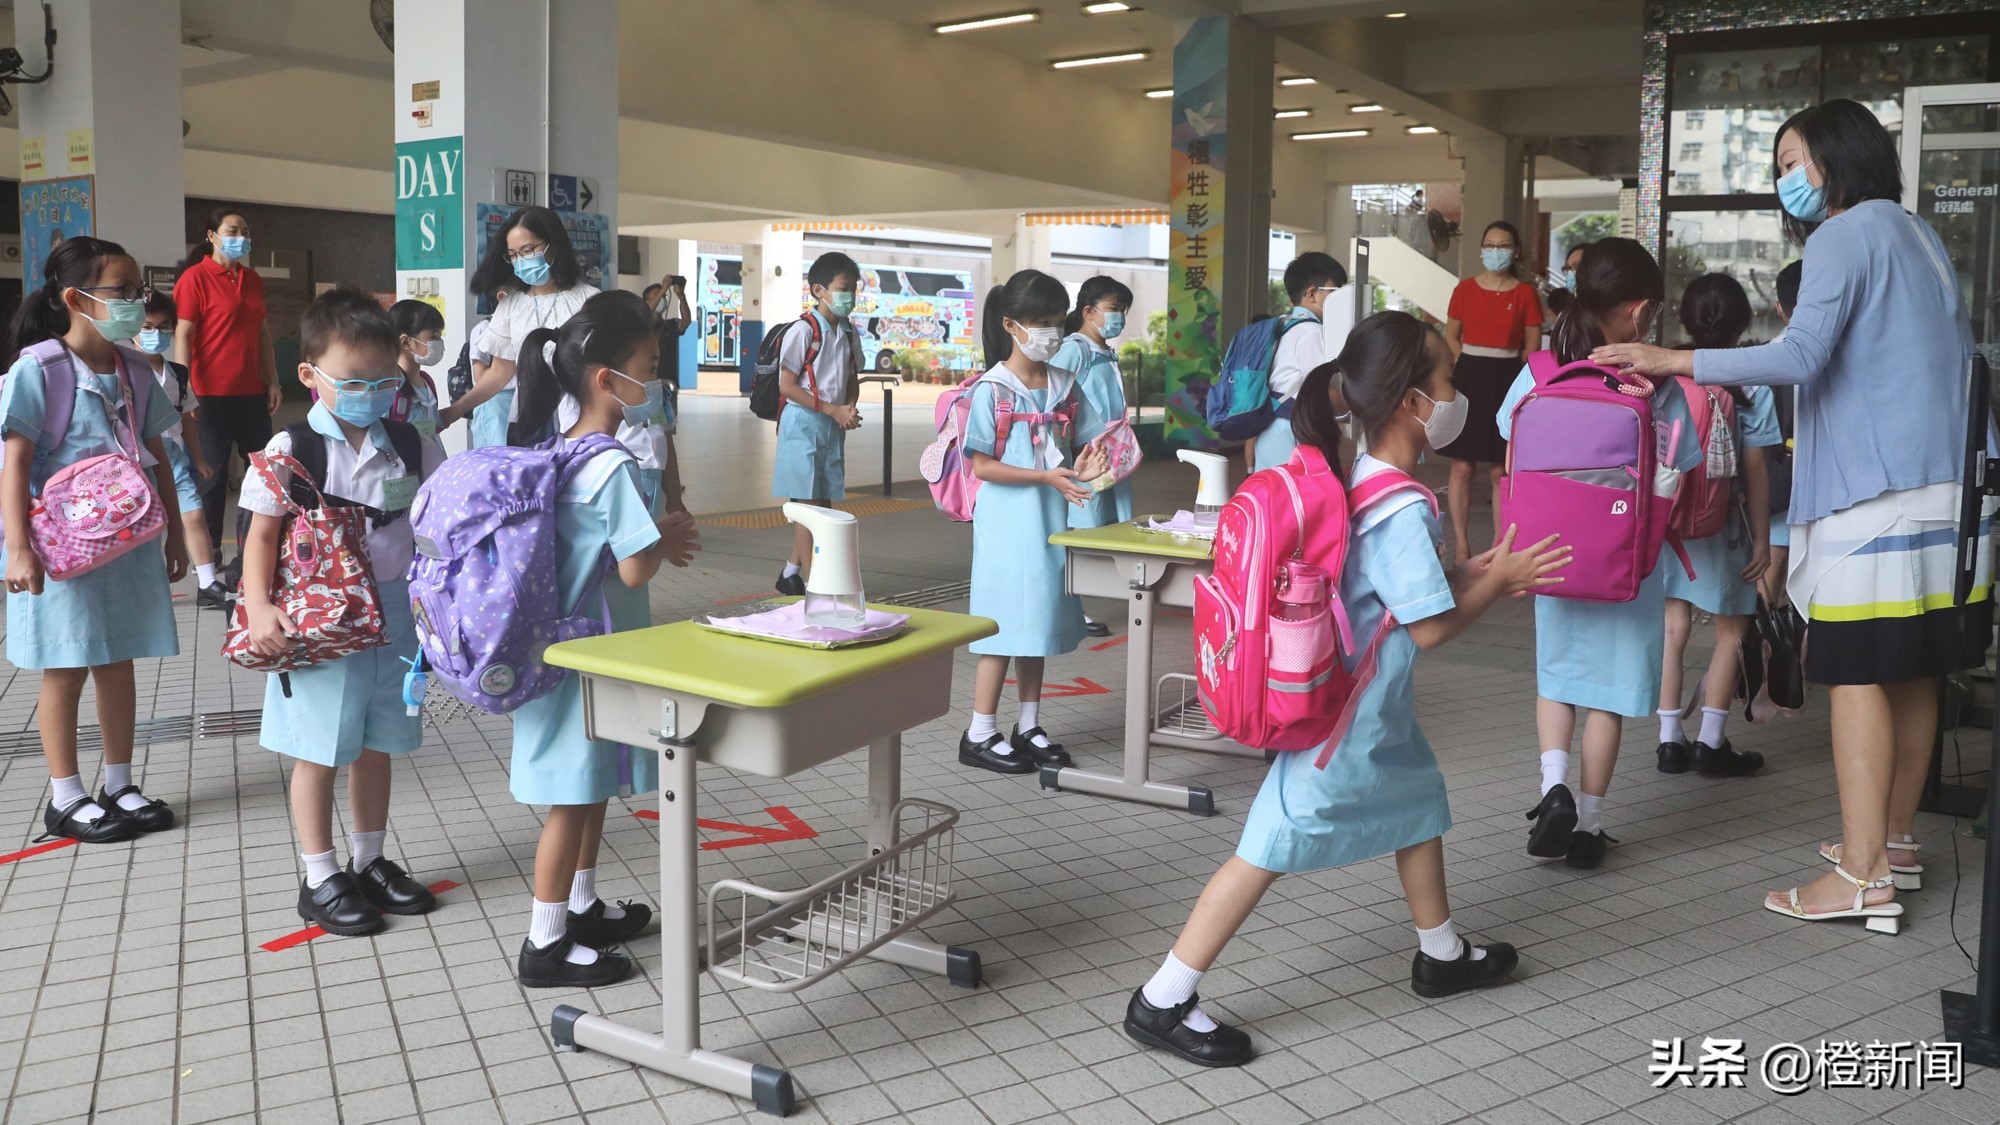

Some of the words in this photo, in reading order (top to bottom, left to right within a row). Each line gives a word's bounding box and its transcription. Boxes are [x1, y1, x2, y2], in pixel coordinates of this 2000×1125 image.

[397, 150, 461, 199] DAY
[1934, 184, 1998, 197] General
[1184, 139, 1210, 291] 犧牲彰主愛
[1934, 201, 1974, 213] 校務處
[420, 213, 436, 252] S
[1615, 502, 1624, 512] K
